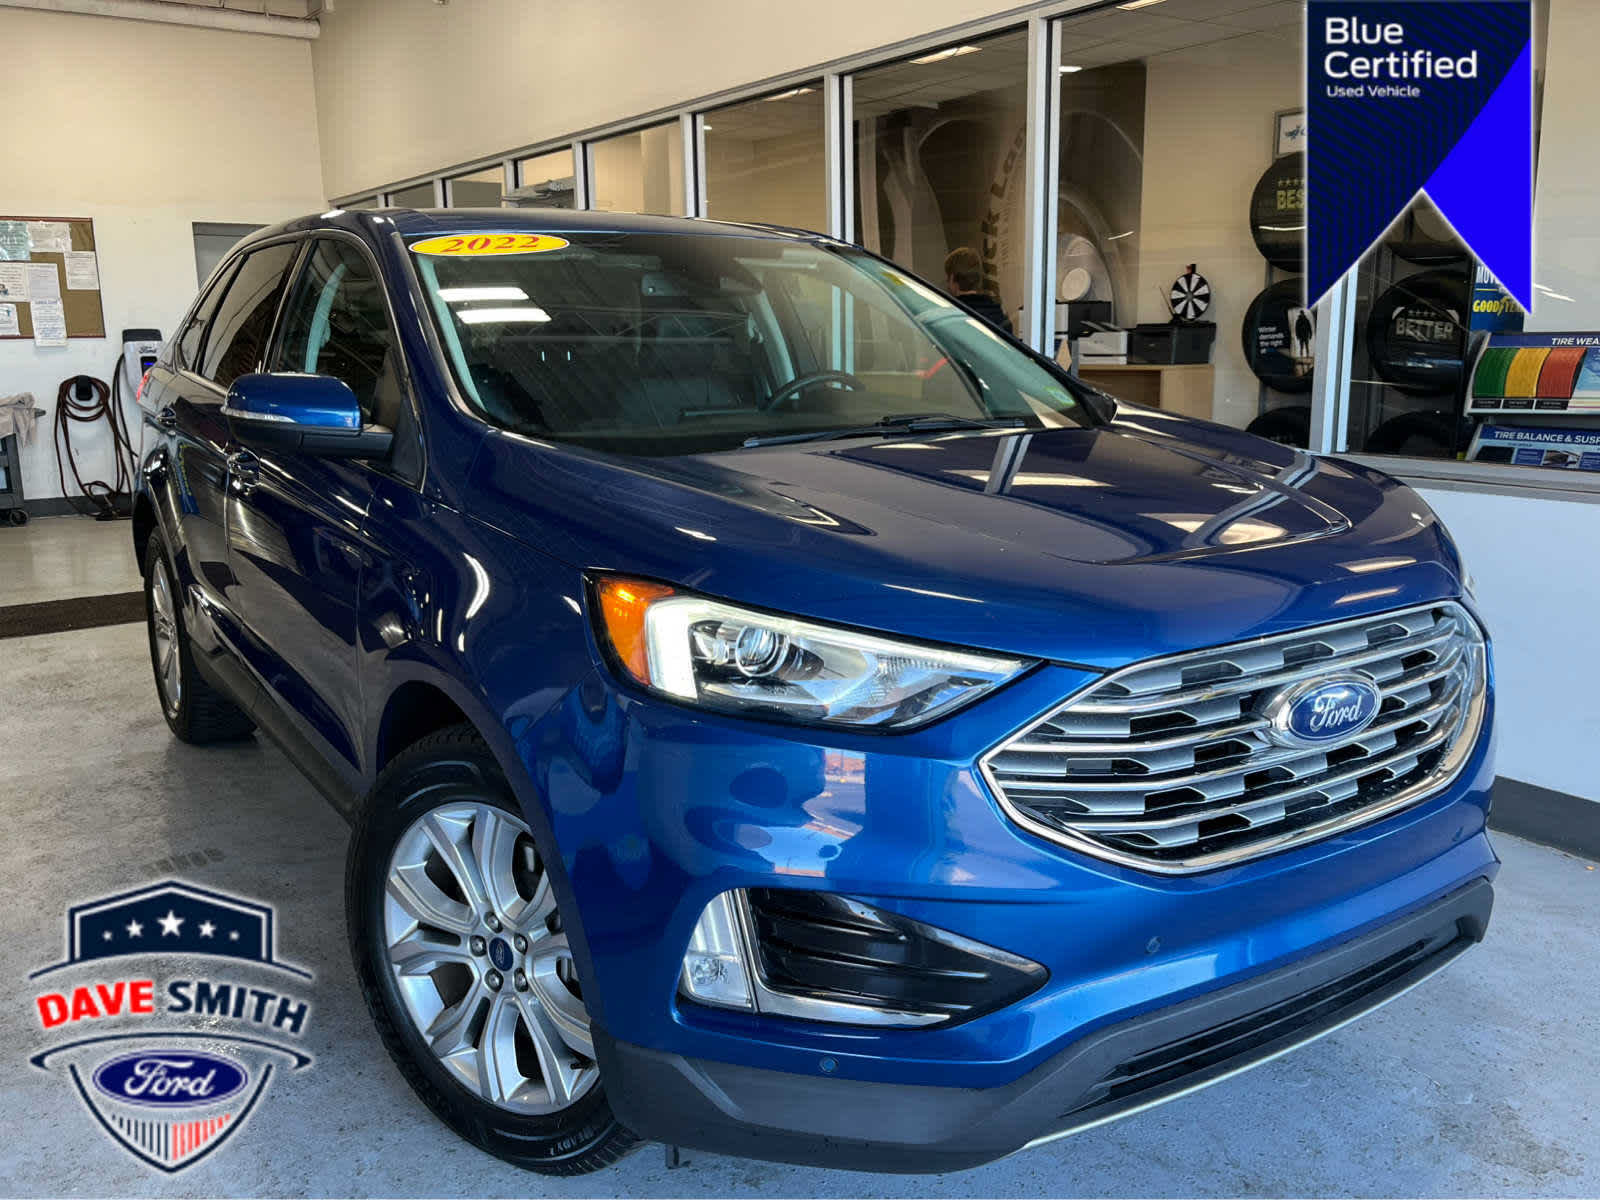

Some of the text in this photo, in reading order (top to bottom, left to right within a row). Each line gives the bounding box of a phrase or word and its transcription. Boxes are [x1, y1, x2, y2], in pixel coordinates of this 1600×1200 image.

[440, 236, 540, 253] 2022
[1551, 337, 1575, 345] TIRE
[1494, 431, 1516, 439] TIRE
[1516, 432, 1563, 442] BALANCE
[1310, 690, 1362, 733] Ford
